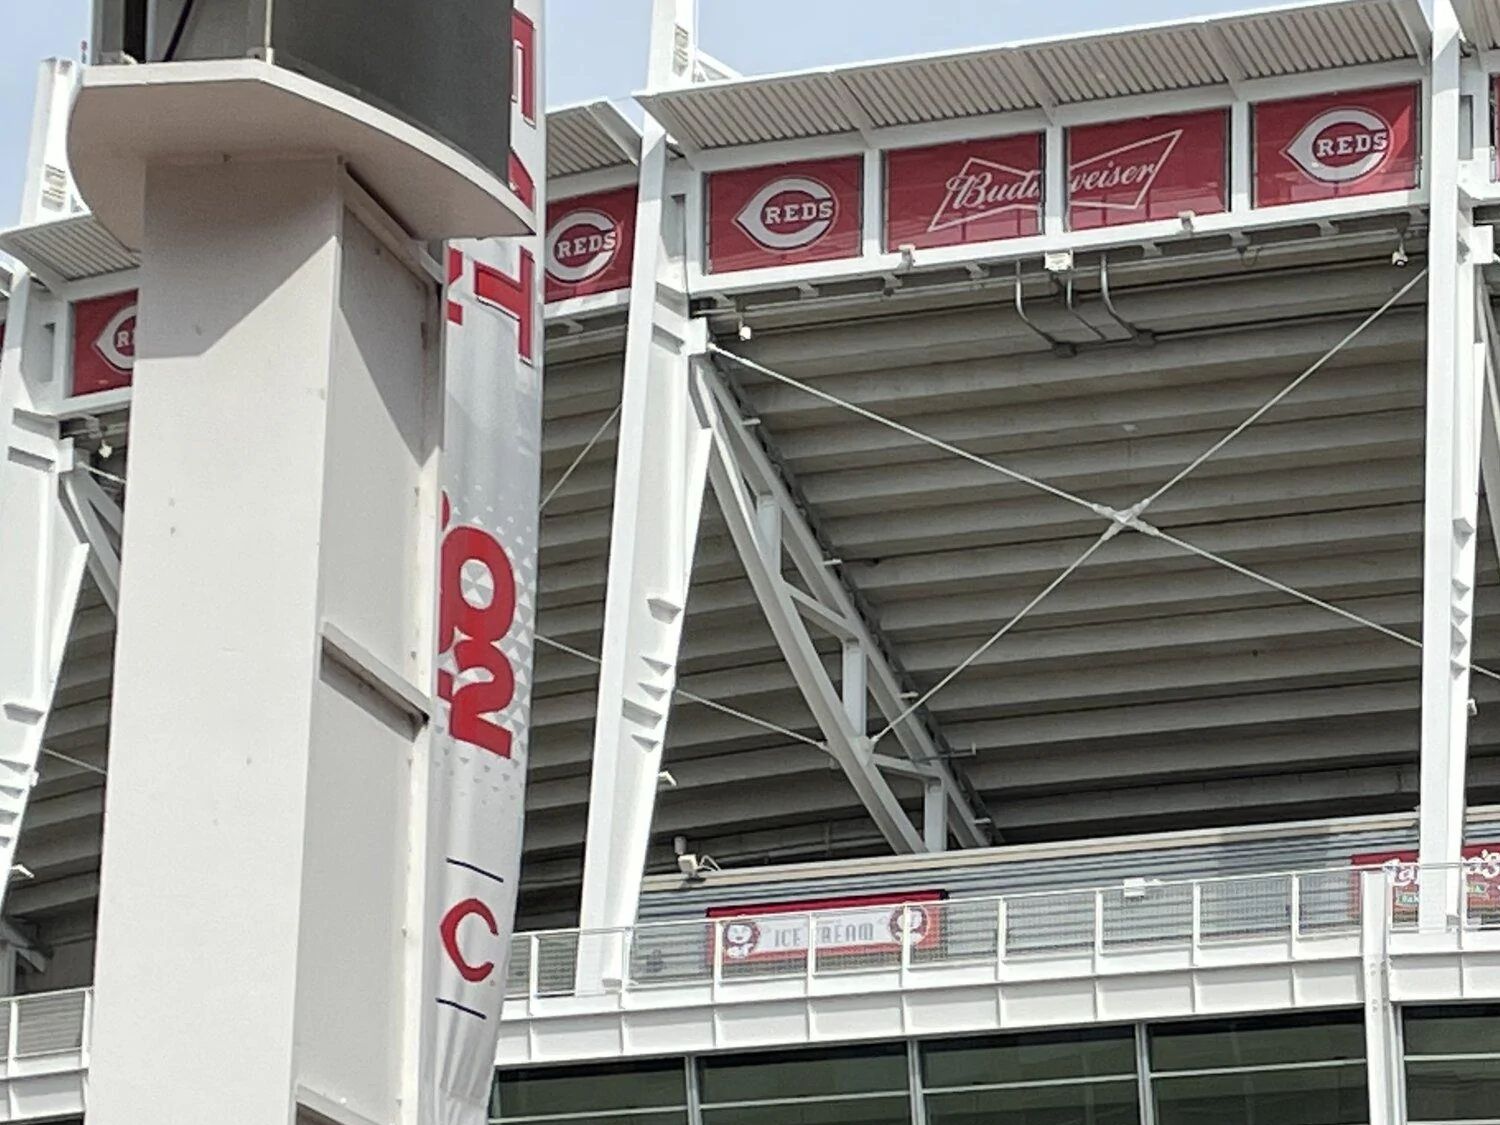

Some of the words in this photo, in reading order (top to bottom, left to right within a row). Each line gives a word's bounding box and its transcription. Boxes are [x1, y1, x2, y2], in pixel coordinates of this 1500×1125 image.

[1316, 130, 1387, 157] REDS
[764, 198, 834, 225] REDS
[556, 230, 616, 259] REDS
[774, 927, 801, 947] ICE
[815, 922, 874, 945] REAM
